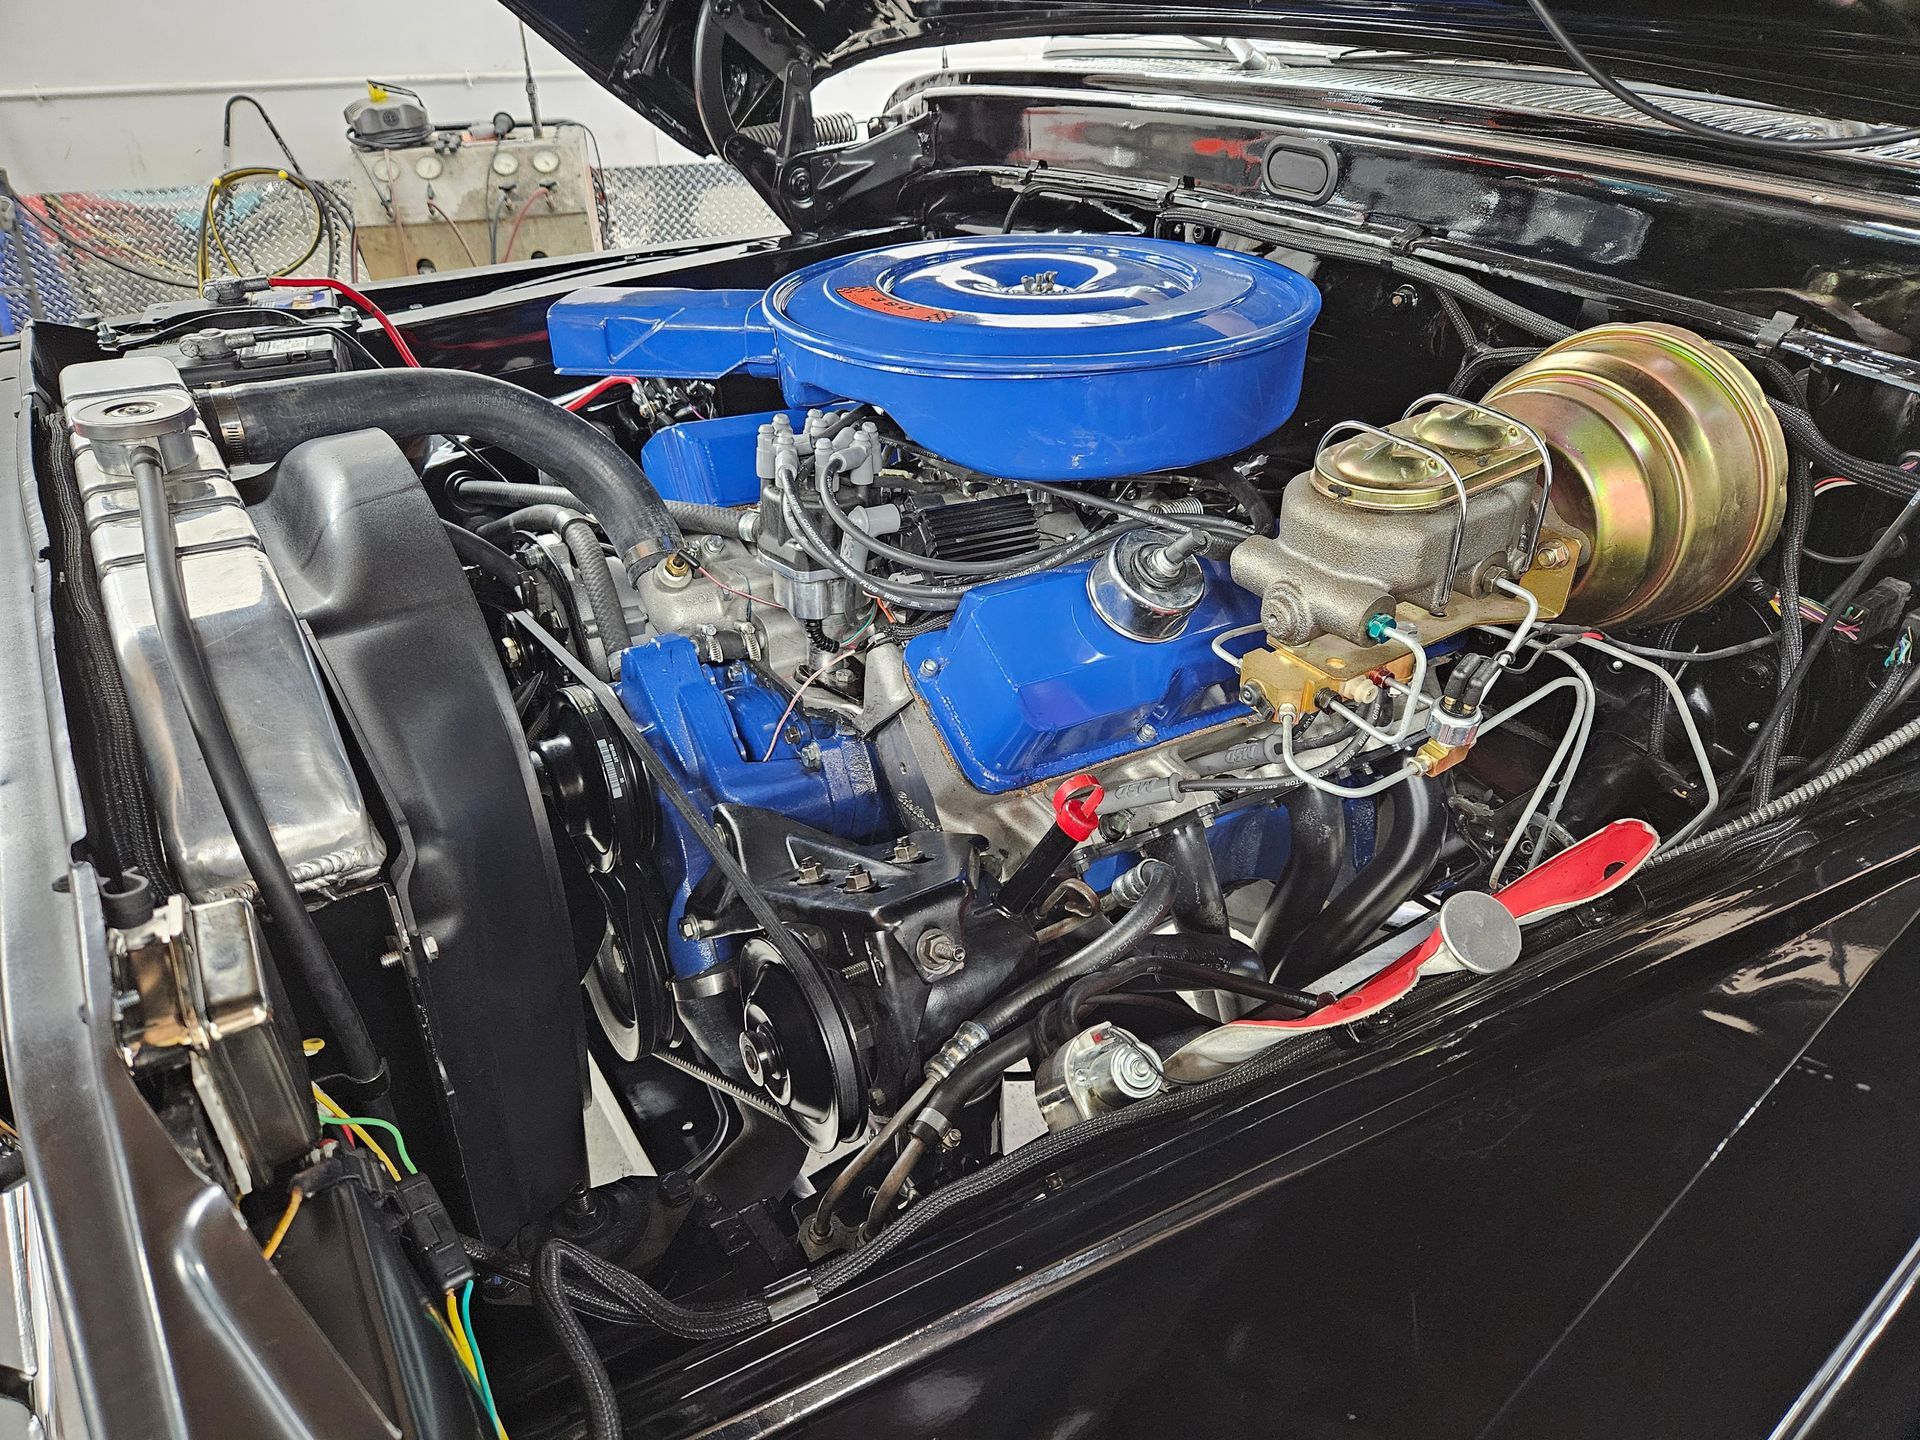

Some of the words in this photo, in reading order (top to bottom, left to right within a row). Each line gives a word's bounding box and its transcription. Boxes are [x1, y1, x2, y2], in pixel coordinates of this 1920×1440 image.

[1169, 522, 1190, 533] SUPER
[801, 518, 832, 557] CONDUCTOR
[834, 559, 857, 579] SPARK
[860, 580, 879, 593] PLUG
[884, 592, 902, 604] WIRE
[1334, 749, 1355, 768] SUPER
[1115, 780, 1155, 799] MSD
